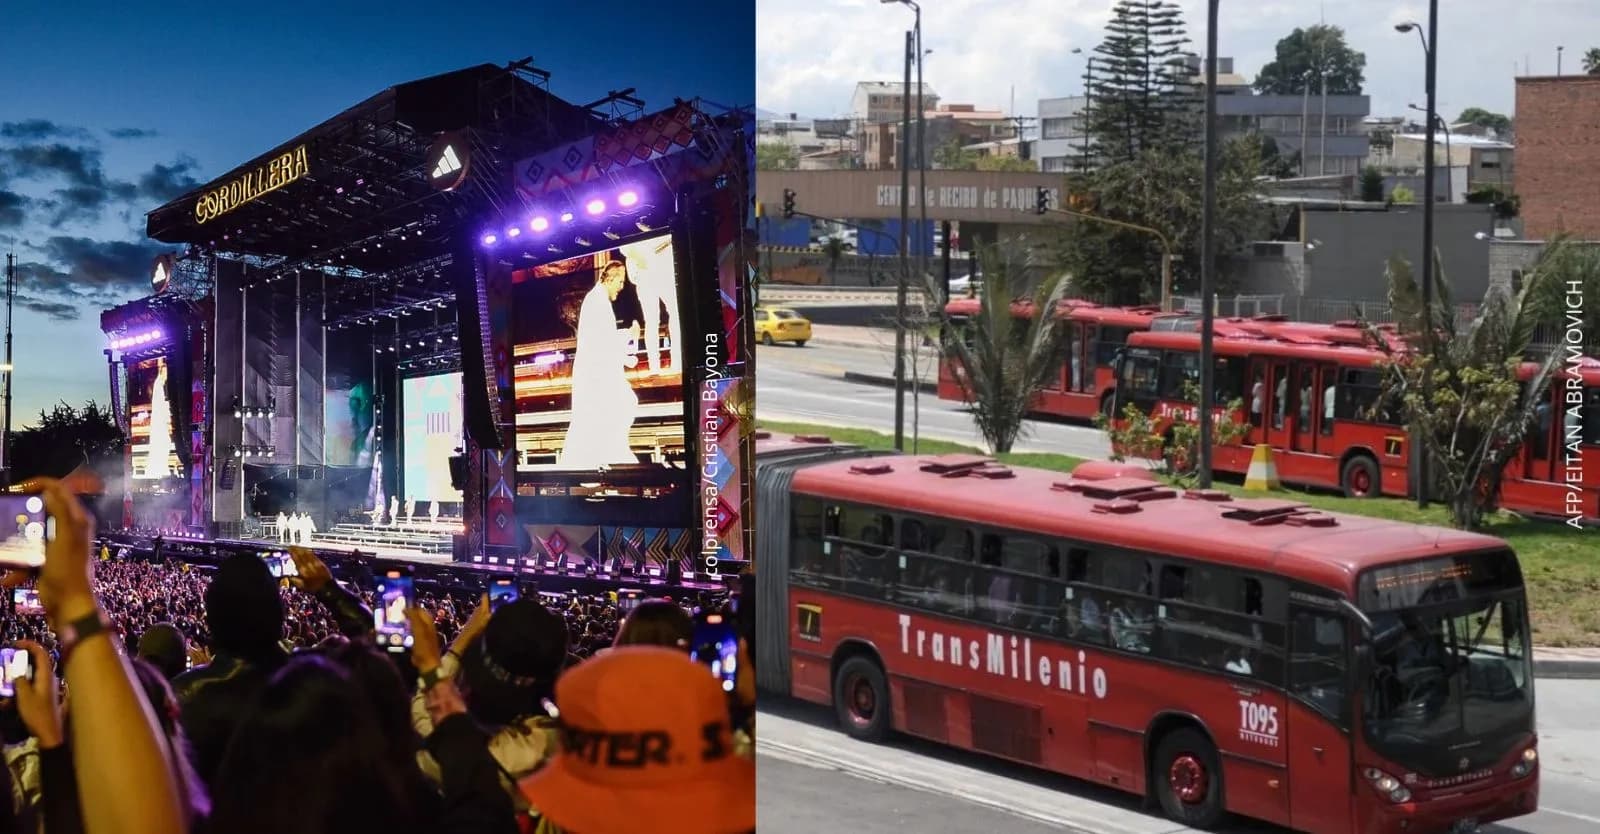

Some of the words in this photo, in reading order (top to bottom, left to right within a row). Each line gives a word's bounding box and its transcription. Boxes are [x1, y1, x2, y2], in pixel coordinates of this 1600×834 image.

[195, 144, 310, 224] CORDILLERA
[877, 184, 916, 207] CENTO
[939, 186, 978, 209] RECIBO
[984, 186, 997, 209] de
[899, 614, 1107, 698] TransMilenio
[1239, 700, 1278, 735] T095
